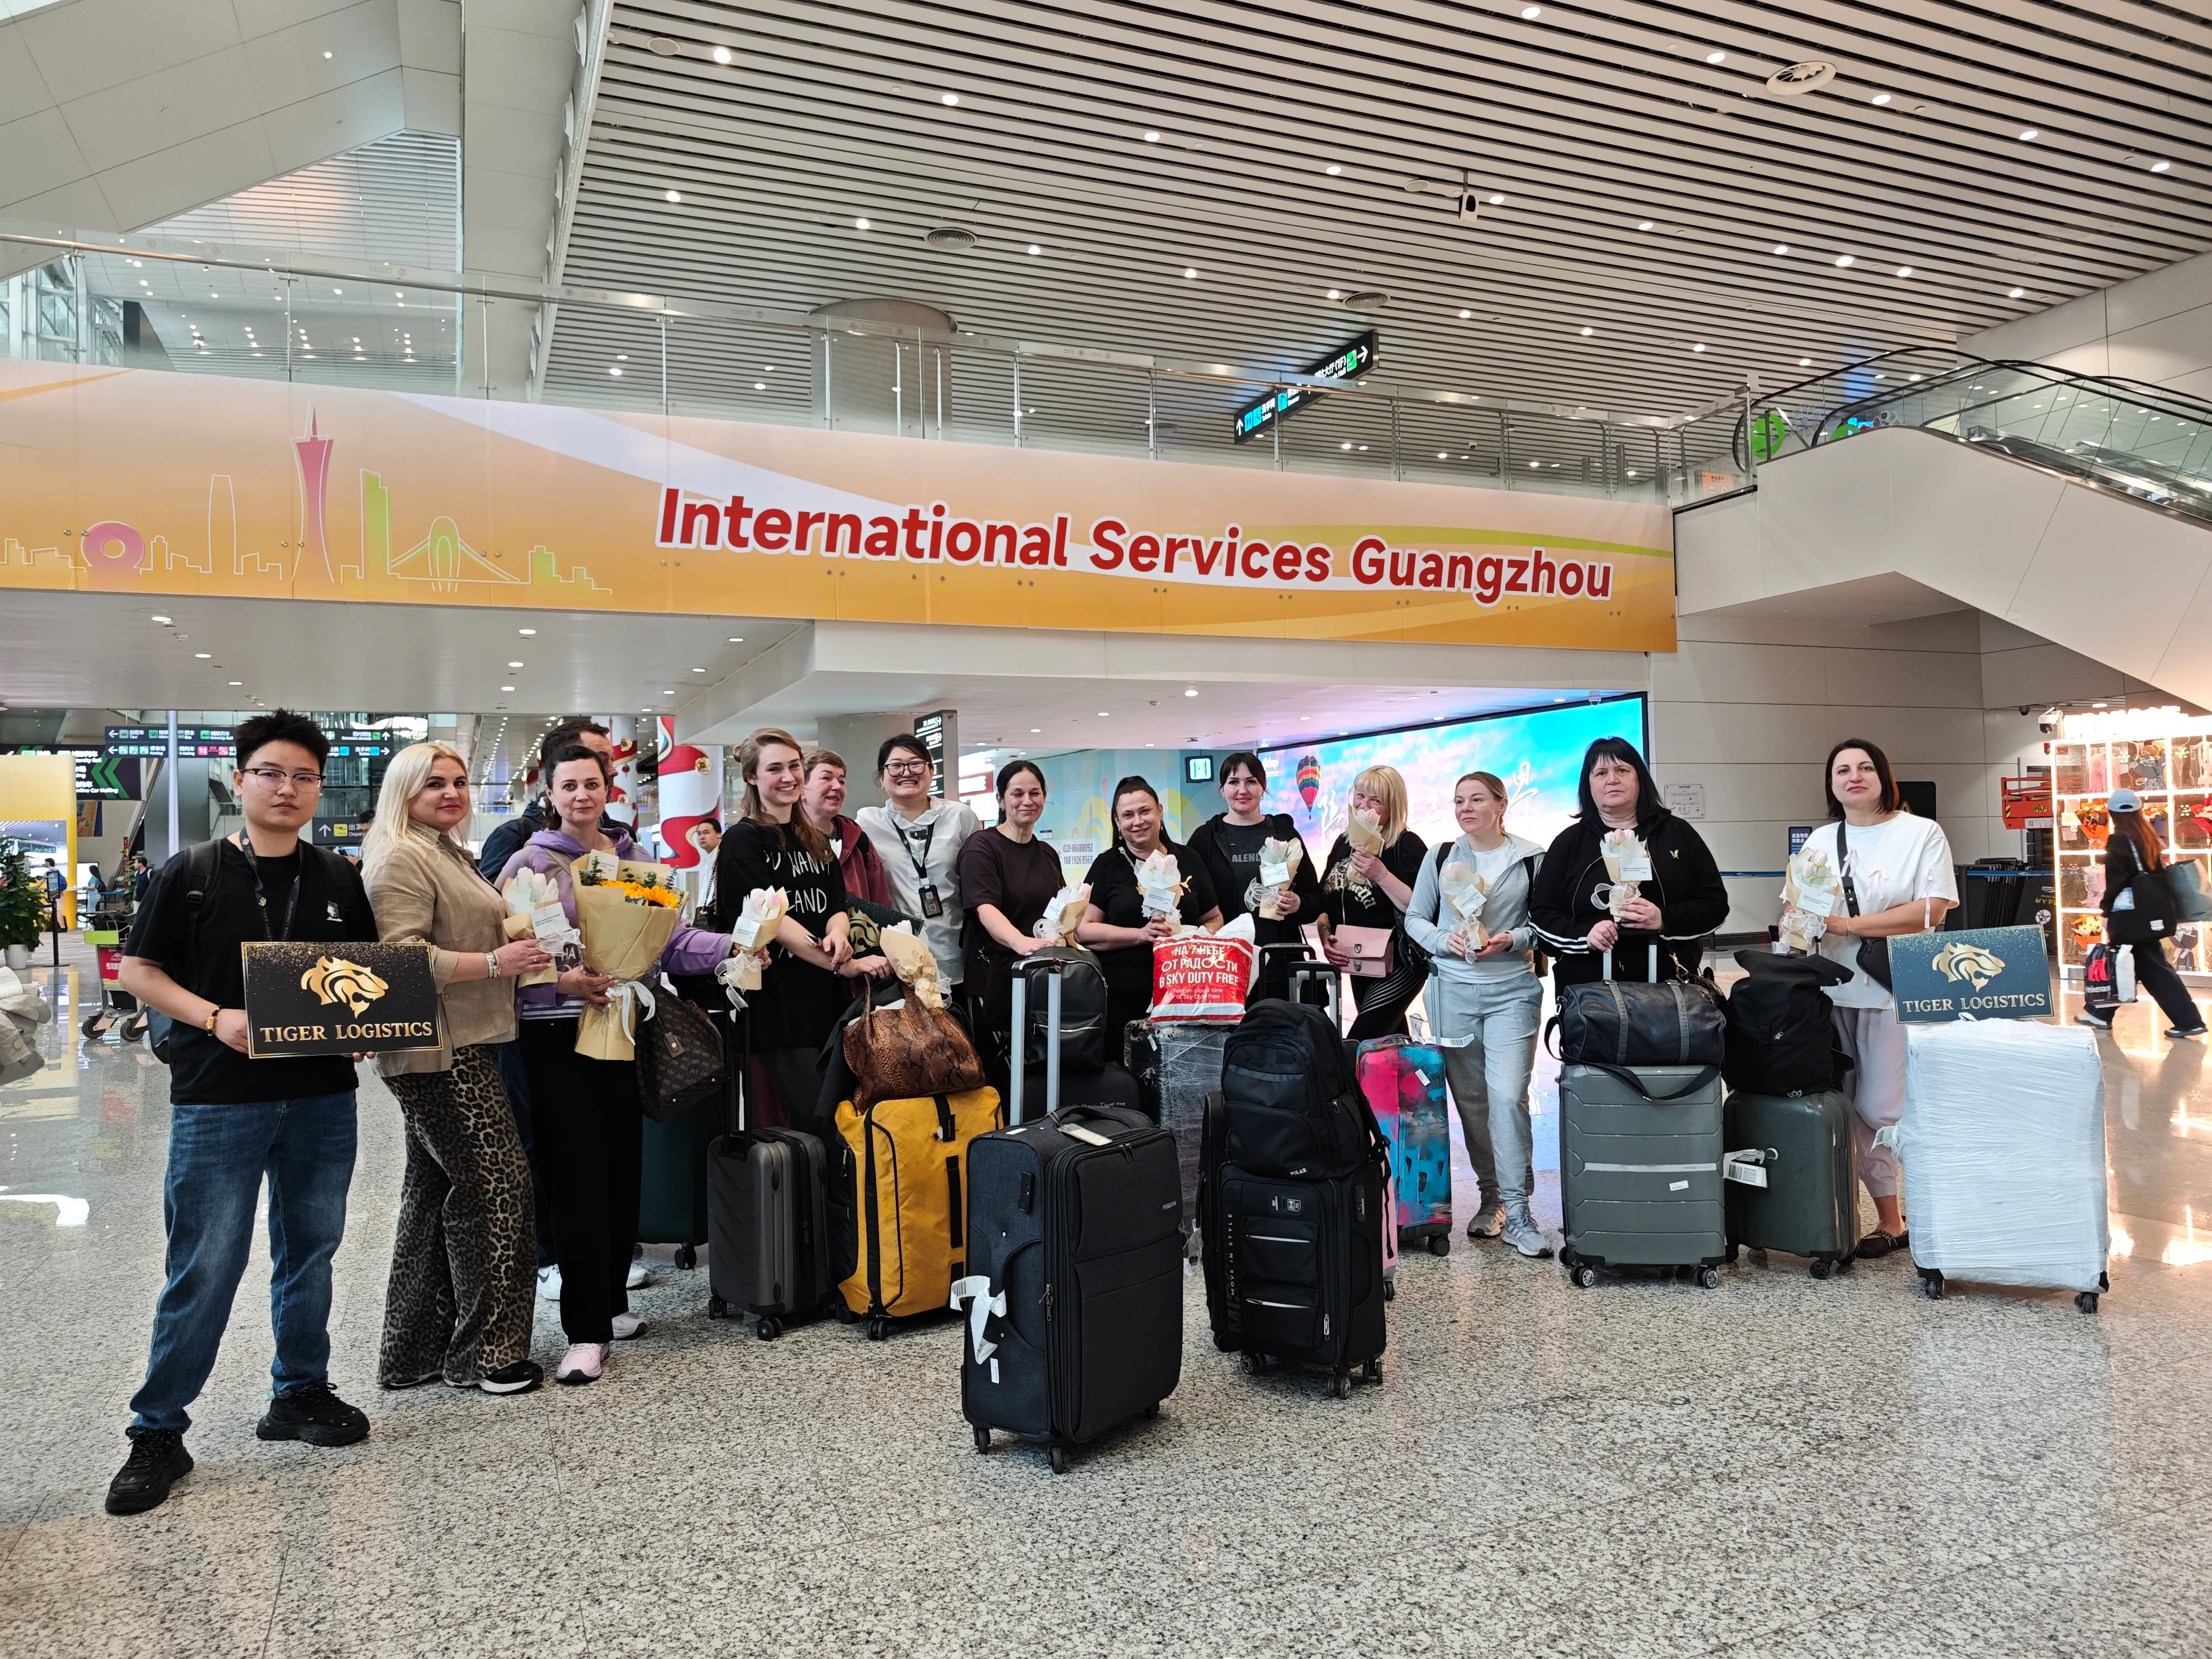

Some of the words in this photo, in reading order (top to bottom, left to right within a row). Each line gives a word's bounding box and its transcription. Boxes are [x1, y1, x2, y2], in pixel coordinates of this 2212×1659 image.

[661, 489, 1068, 567] International
[1090, 521, 1330, 582] Services
[1353, 539, 1610, 604] Guangzhou
[1175, 946, 1189, 956] НА
[1201, 945, 1225, 955] НЕБЕ
[1162, 959, 1178, 972] ОТ
[1180, 958, 1238, 974] РАДОСТИ
[1166, 973, 1185, 985] SKY
[1188, 972, 1214, 983] DUTY
[1216, 972, 1239, 986] FREE
[1903, 999, 1954, 1013] TIGER
[1960, 993, 2045, 1010] LOGISTICS
[260, 1026, 328, 1042] TIGER
[335, 1022, 433, 1040] LOGISTICS
[1290, 1168, 1307, 1176] POLAR
[1162, 1200, 1177, 1211] FREEDOM
[1229, 1253, 1233, 1263] IN
